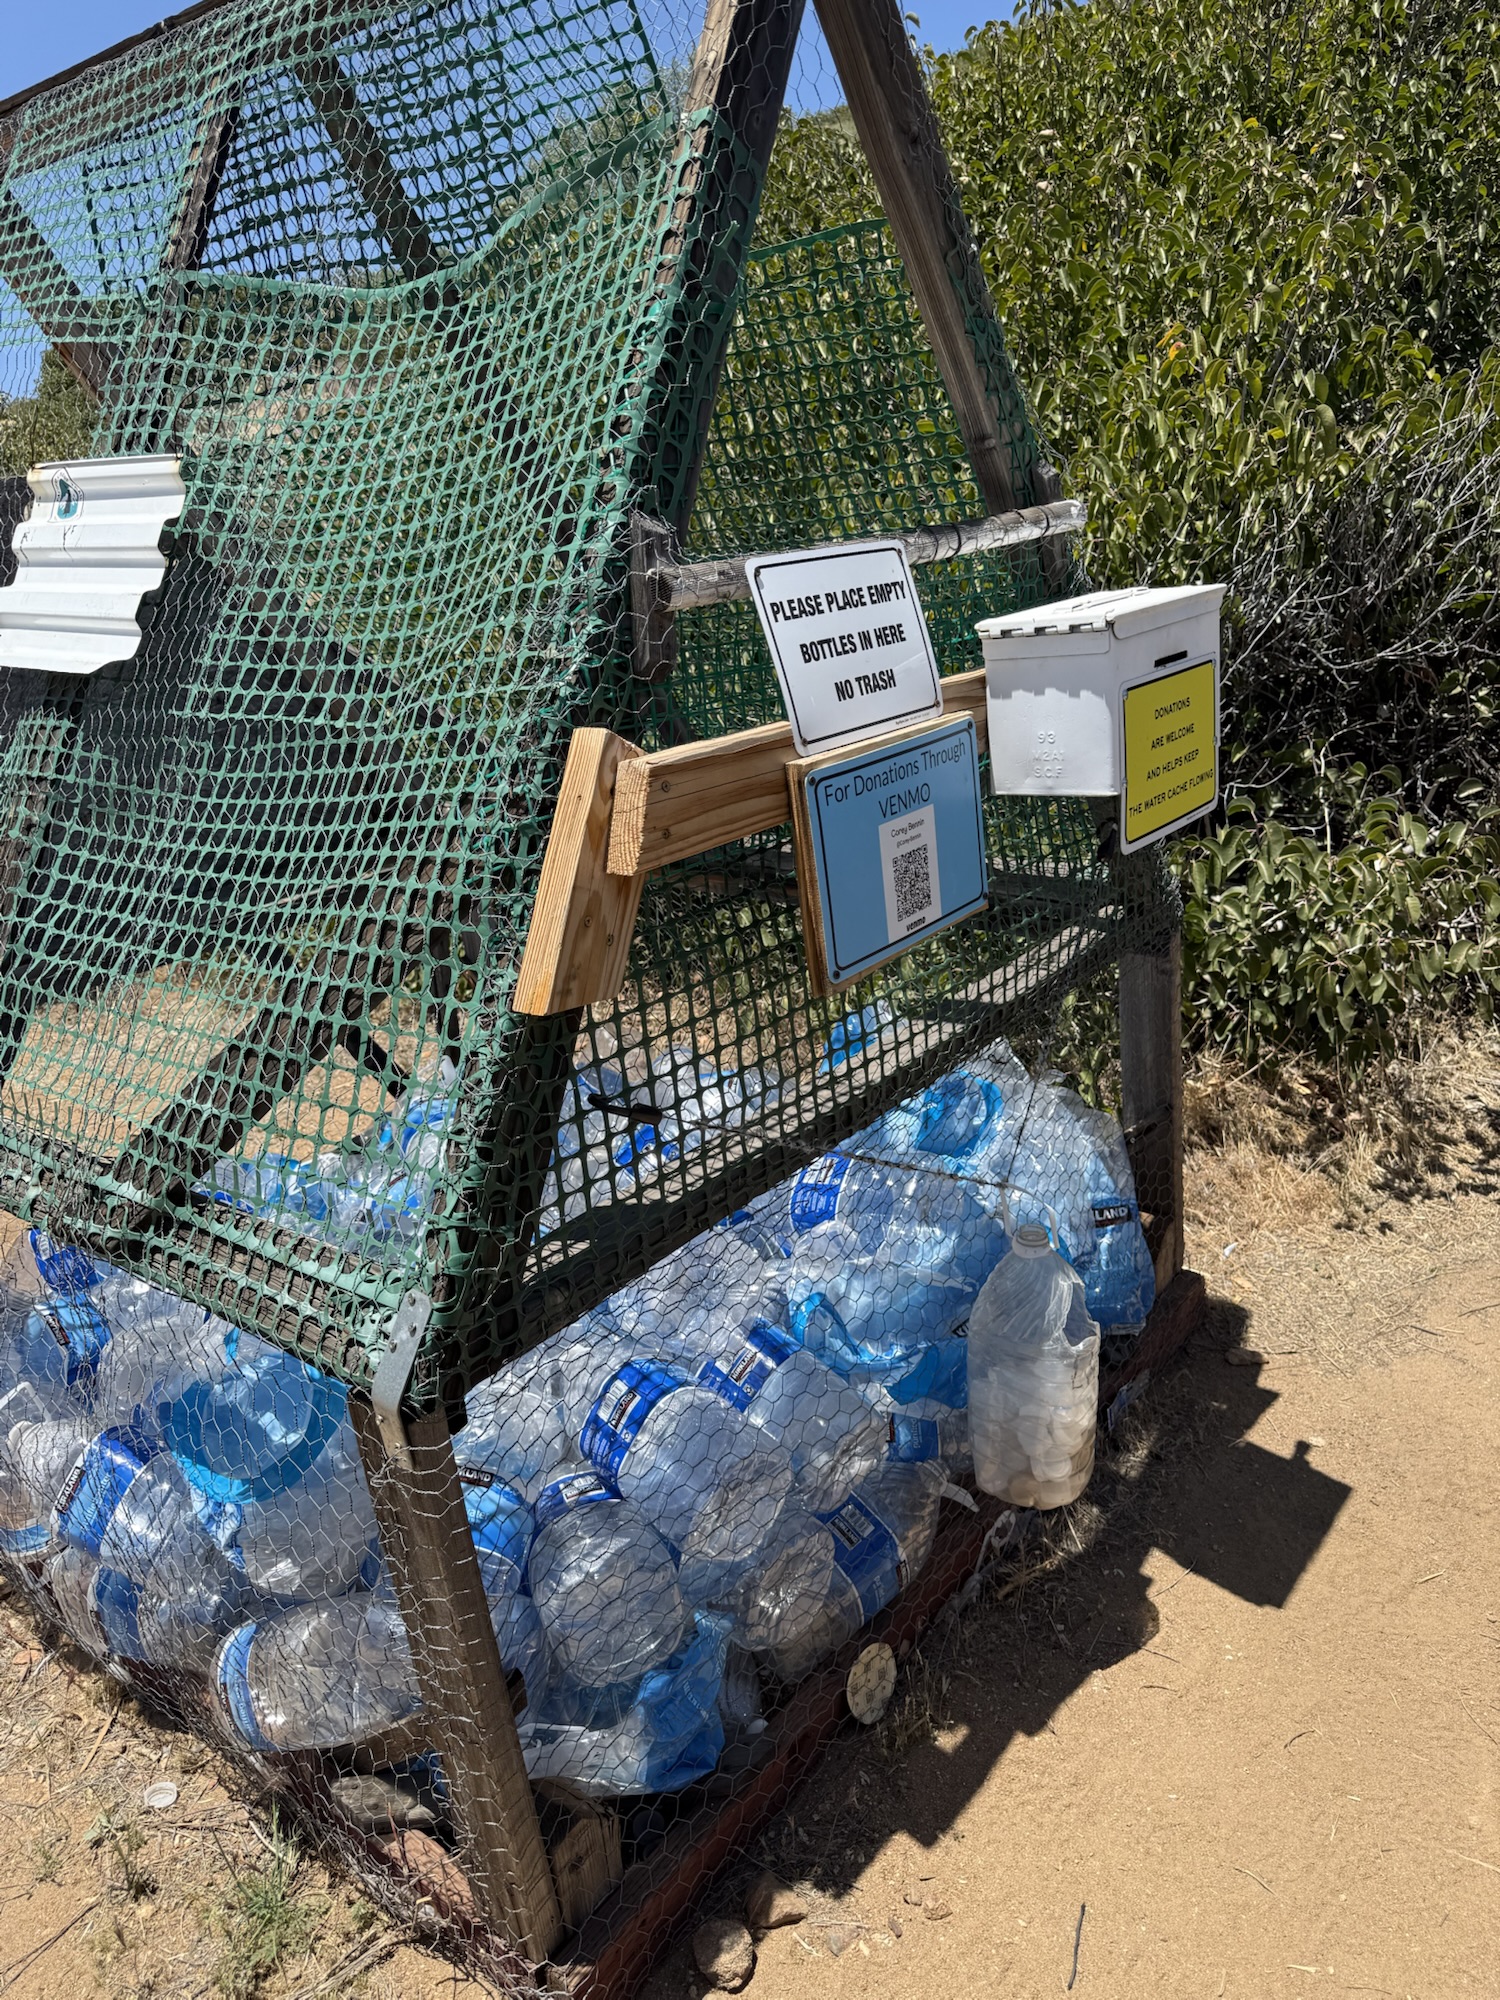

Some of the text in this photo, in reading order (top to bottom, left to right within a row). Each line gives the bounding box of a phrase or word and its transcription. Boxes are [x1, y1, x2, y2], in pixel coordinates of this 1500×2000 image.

[770, 580, 906, 623] PLEASE PLACE EMPTY
[799, 622, 906, 664] BOTTLES IN HERE
[834, 668, 897, 702] NO TRASH
[1154, 696, 1191, 720] DONATIONS
[1037, 730, 1057, 745] 93
[1150, 723, 1195, 751] ARE WELCOME
[823, 737, 966, 807] For Donations Through
[1146, 748, 1199, 782] AND HELPS KEEP
[878, 782, 931, 819] VENMO
[1129, 768, 1214, 818] THE WATER CACHE FLOWING
[890, 825, 908, 838] Corey
[906, 915, 926, 932] venmo
